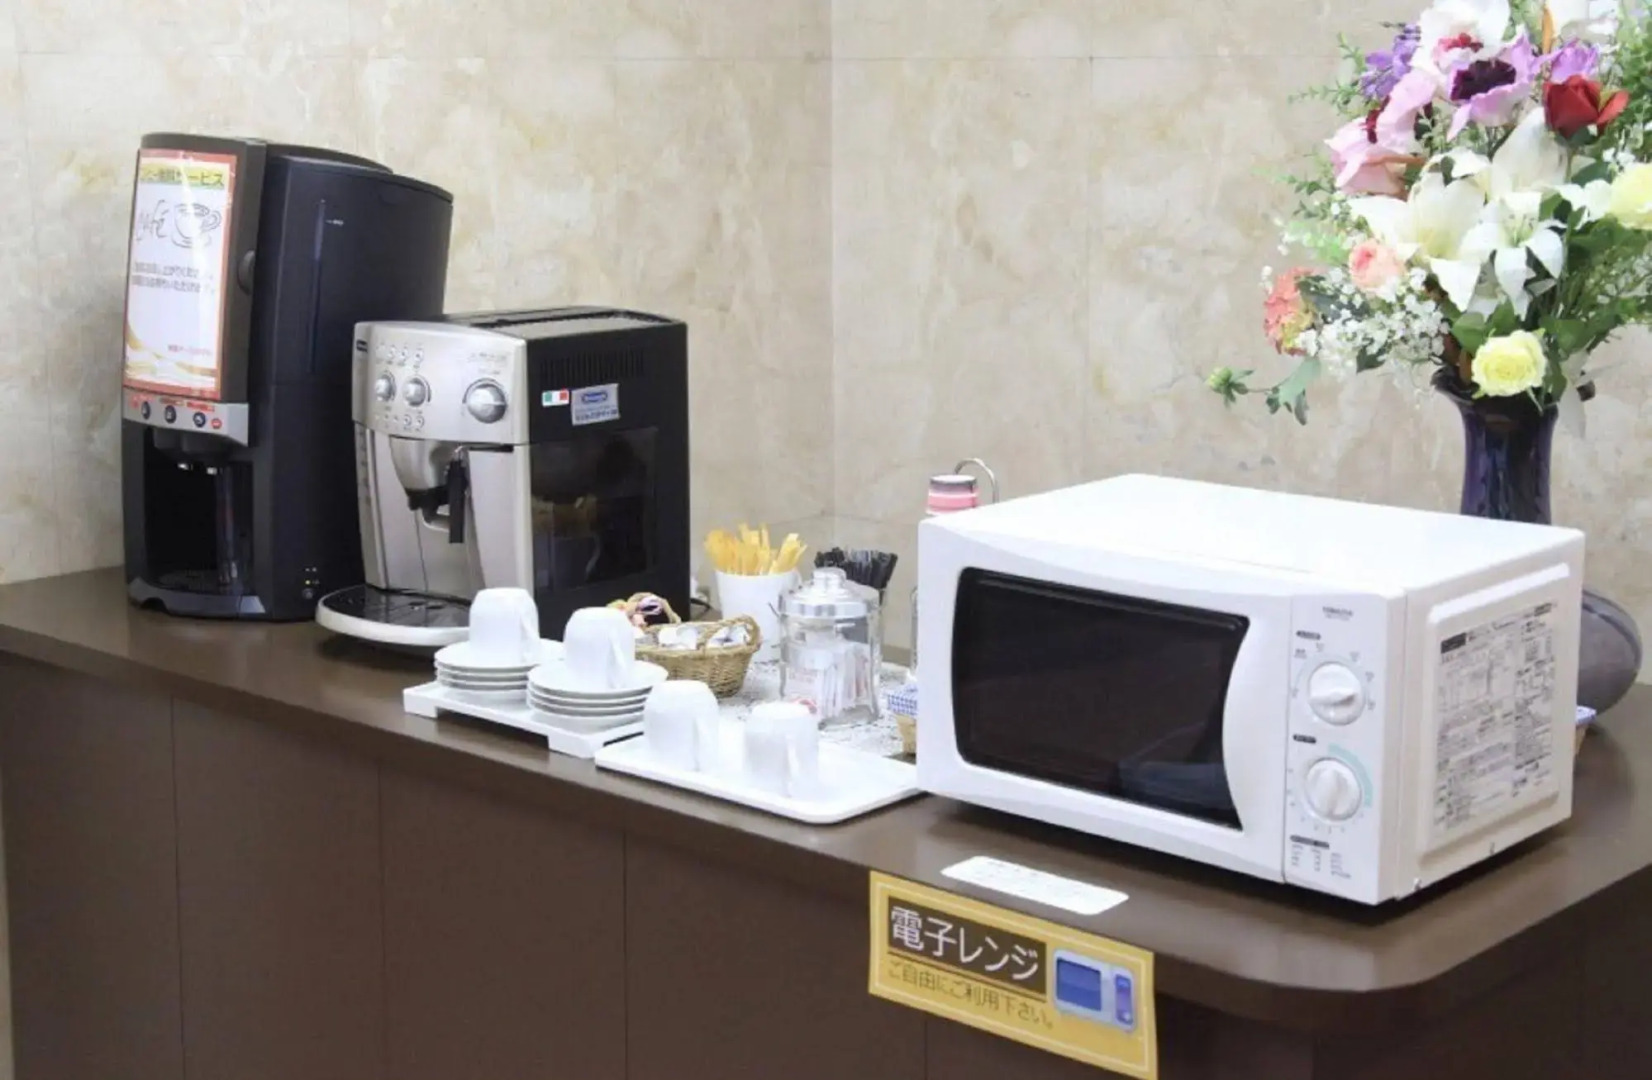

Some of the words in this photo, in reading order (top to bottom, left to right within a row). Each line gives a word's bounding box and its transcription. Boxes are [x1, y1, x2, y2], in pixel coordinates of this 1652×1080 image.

[891, 906, 1038, 980] 電子レンジ
[888, 961, 1053, 1029] ご自由にご利用下さい。
